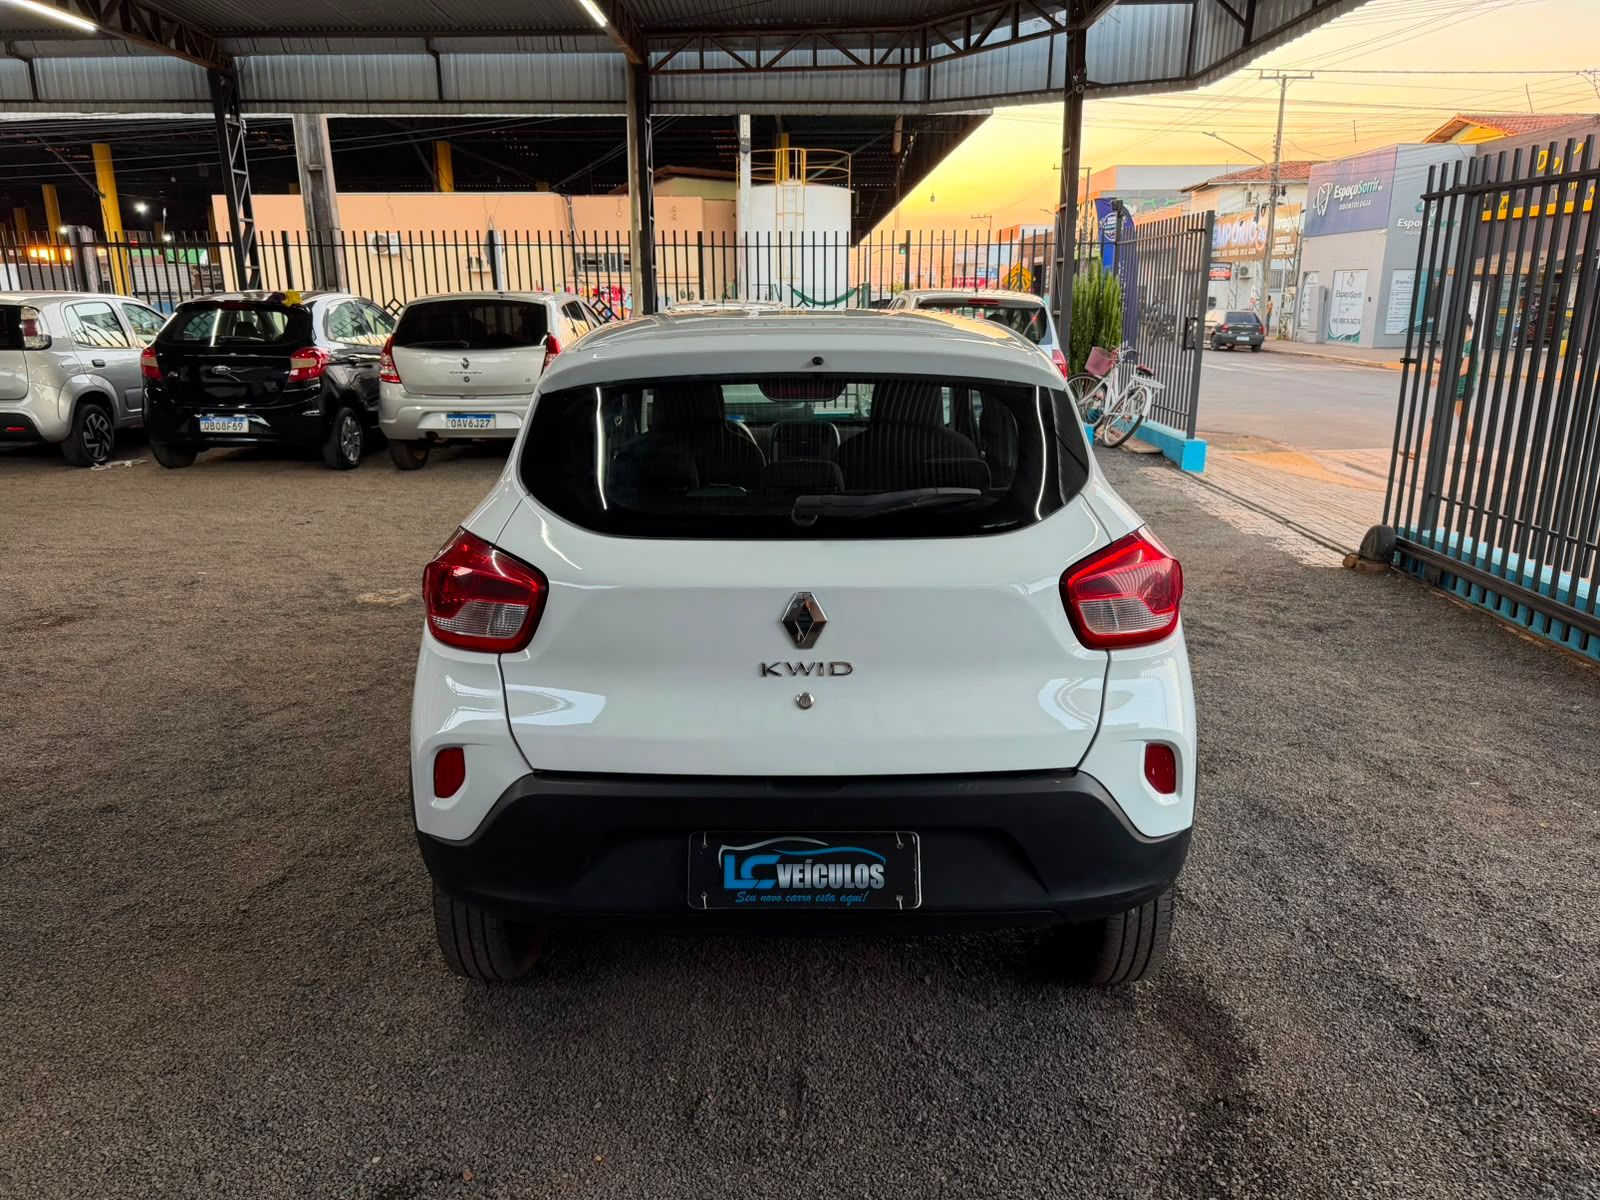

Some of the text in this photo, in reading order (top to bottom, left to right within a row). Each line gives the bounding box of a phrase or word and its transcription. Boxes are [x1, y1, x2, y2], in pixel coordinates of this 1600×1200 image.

[761, 661, 853, 677] KWID
[723, 854, 885, 890] LC VEÍCULOS
[735, 890, 870, 906] Seu novo carro esta aqui!
